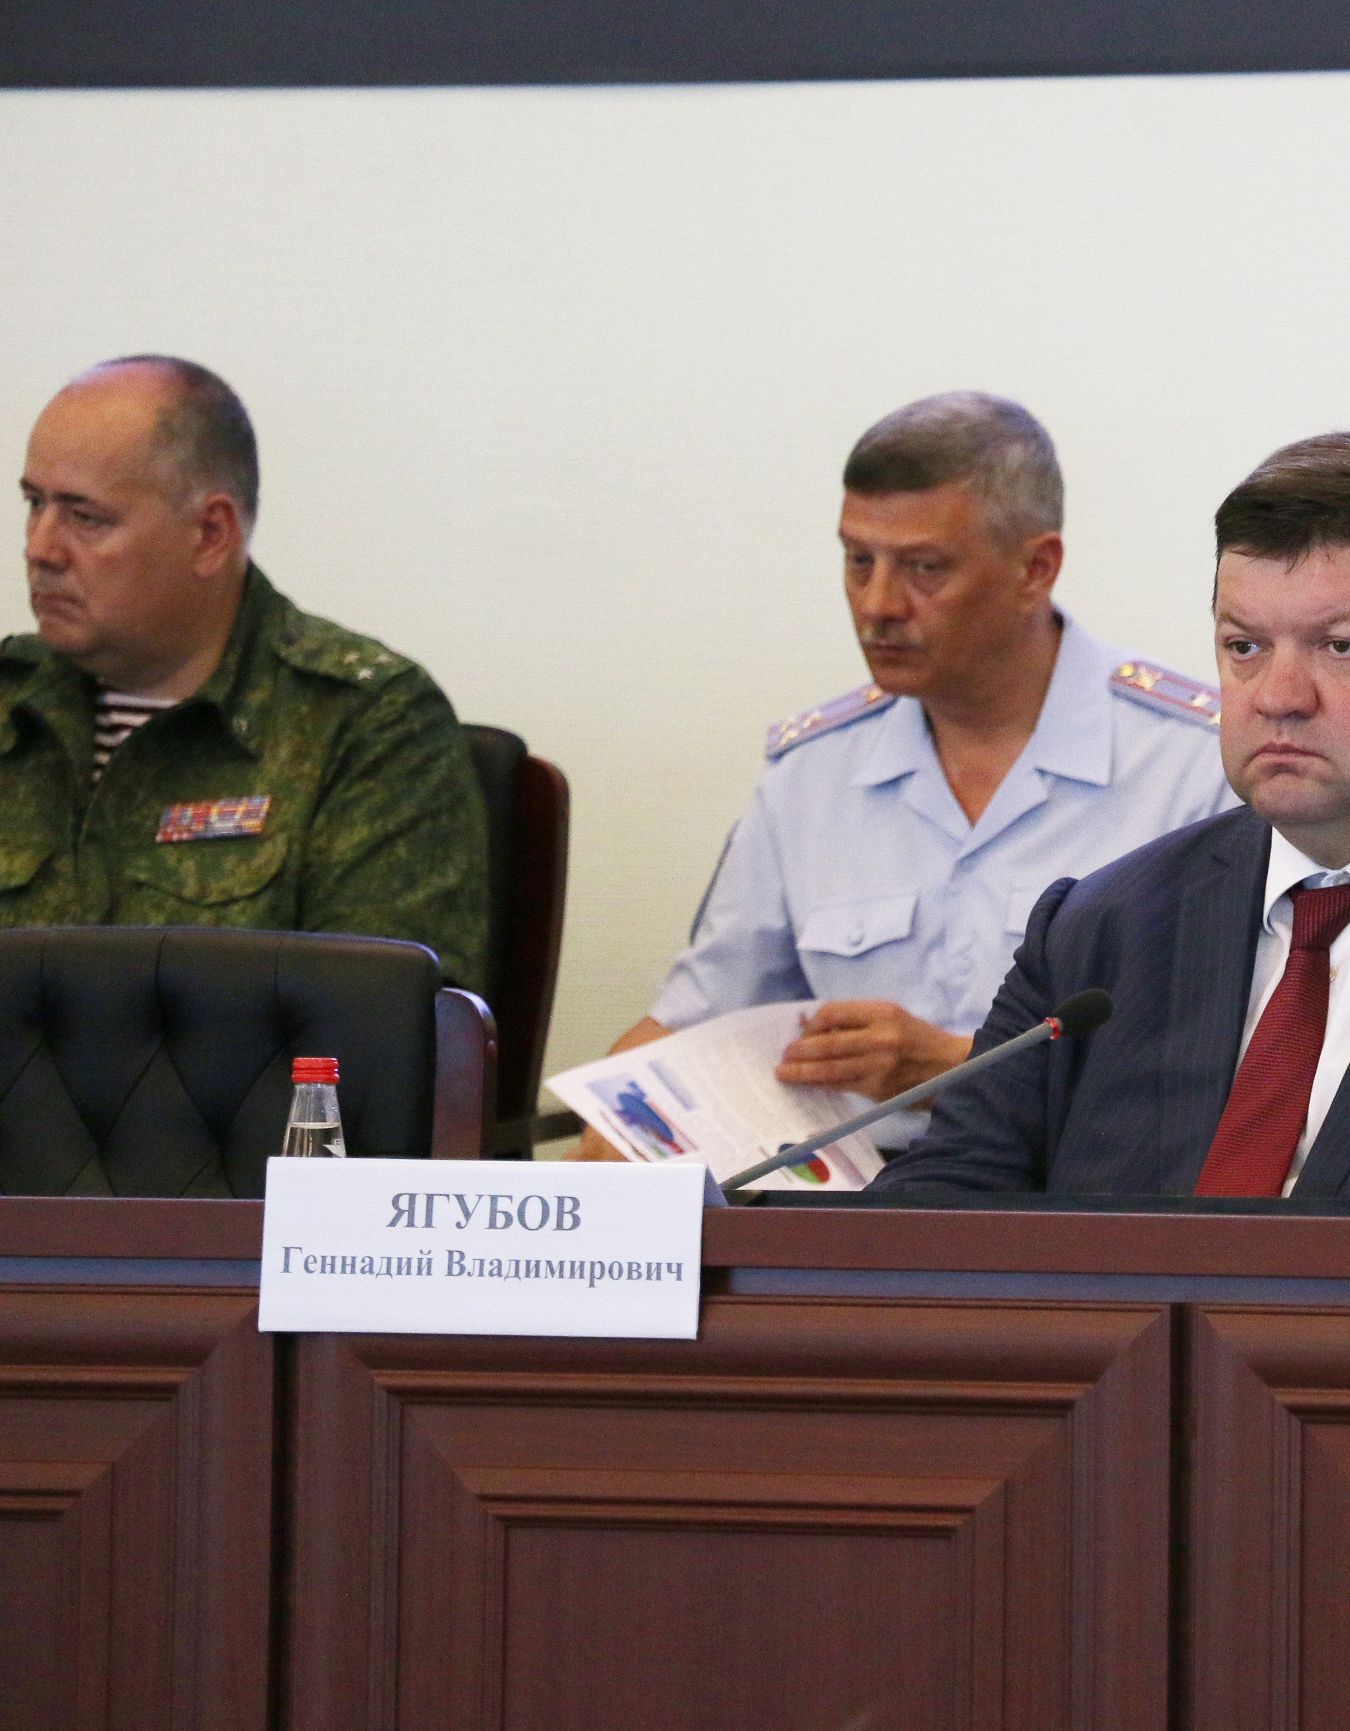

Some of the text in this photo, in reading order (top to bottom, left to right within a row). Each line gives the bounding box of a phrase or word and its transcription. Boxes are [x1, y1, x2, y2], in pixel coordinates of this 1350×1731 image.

[386, 1192, 582, 1232] ЯГУБОВ
[281, 1246, 684, 1288] Геннадий Владимирович
